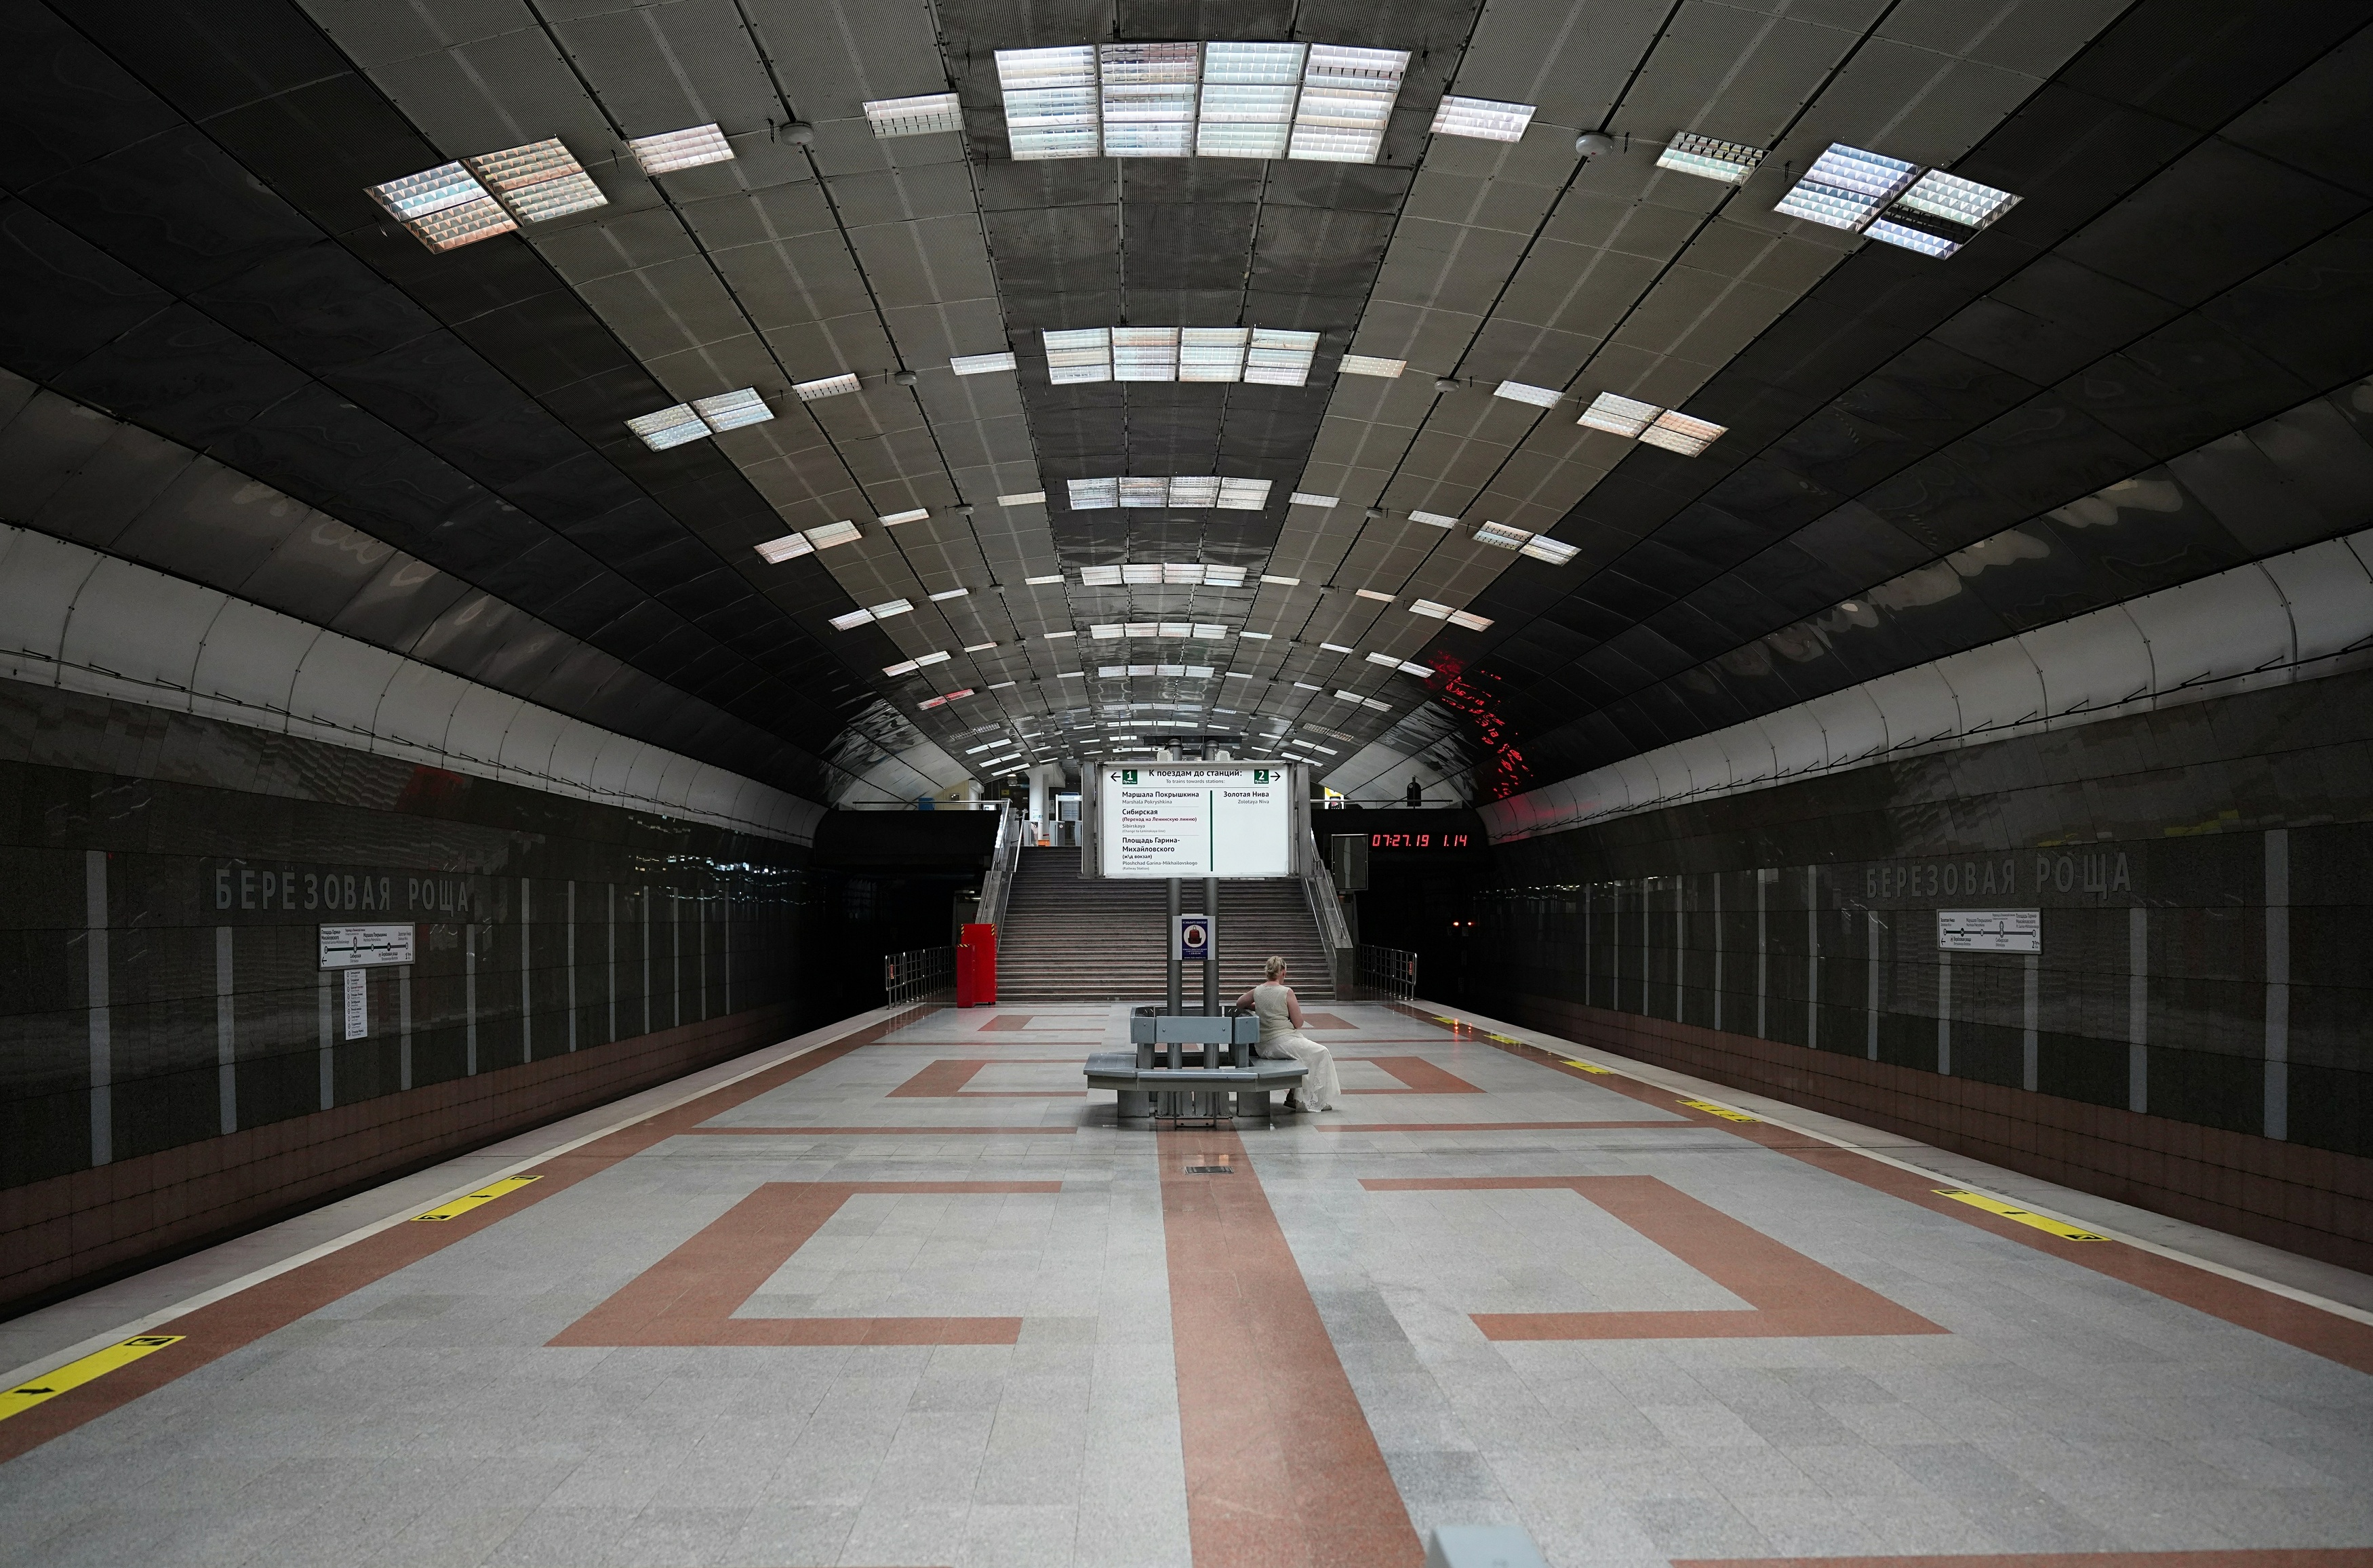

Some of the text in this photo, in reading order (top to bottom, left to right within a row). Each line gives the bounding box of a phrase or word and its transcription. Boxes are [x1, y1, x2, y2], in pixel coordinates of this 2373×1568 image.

[1127, 770, 1133, 780] 1
[1207, 769, 1242, 778] станций:
[1258, 770, 1264, 780] 2
[1866, 851, 2132, 900] БЕРЁЗОВАЯ РОЩА
[408, 877, 470, 917] РОЩА
